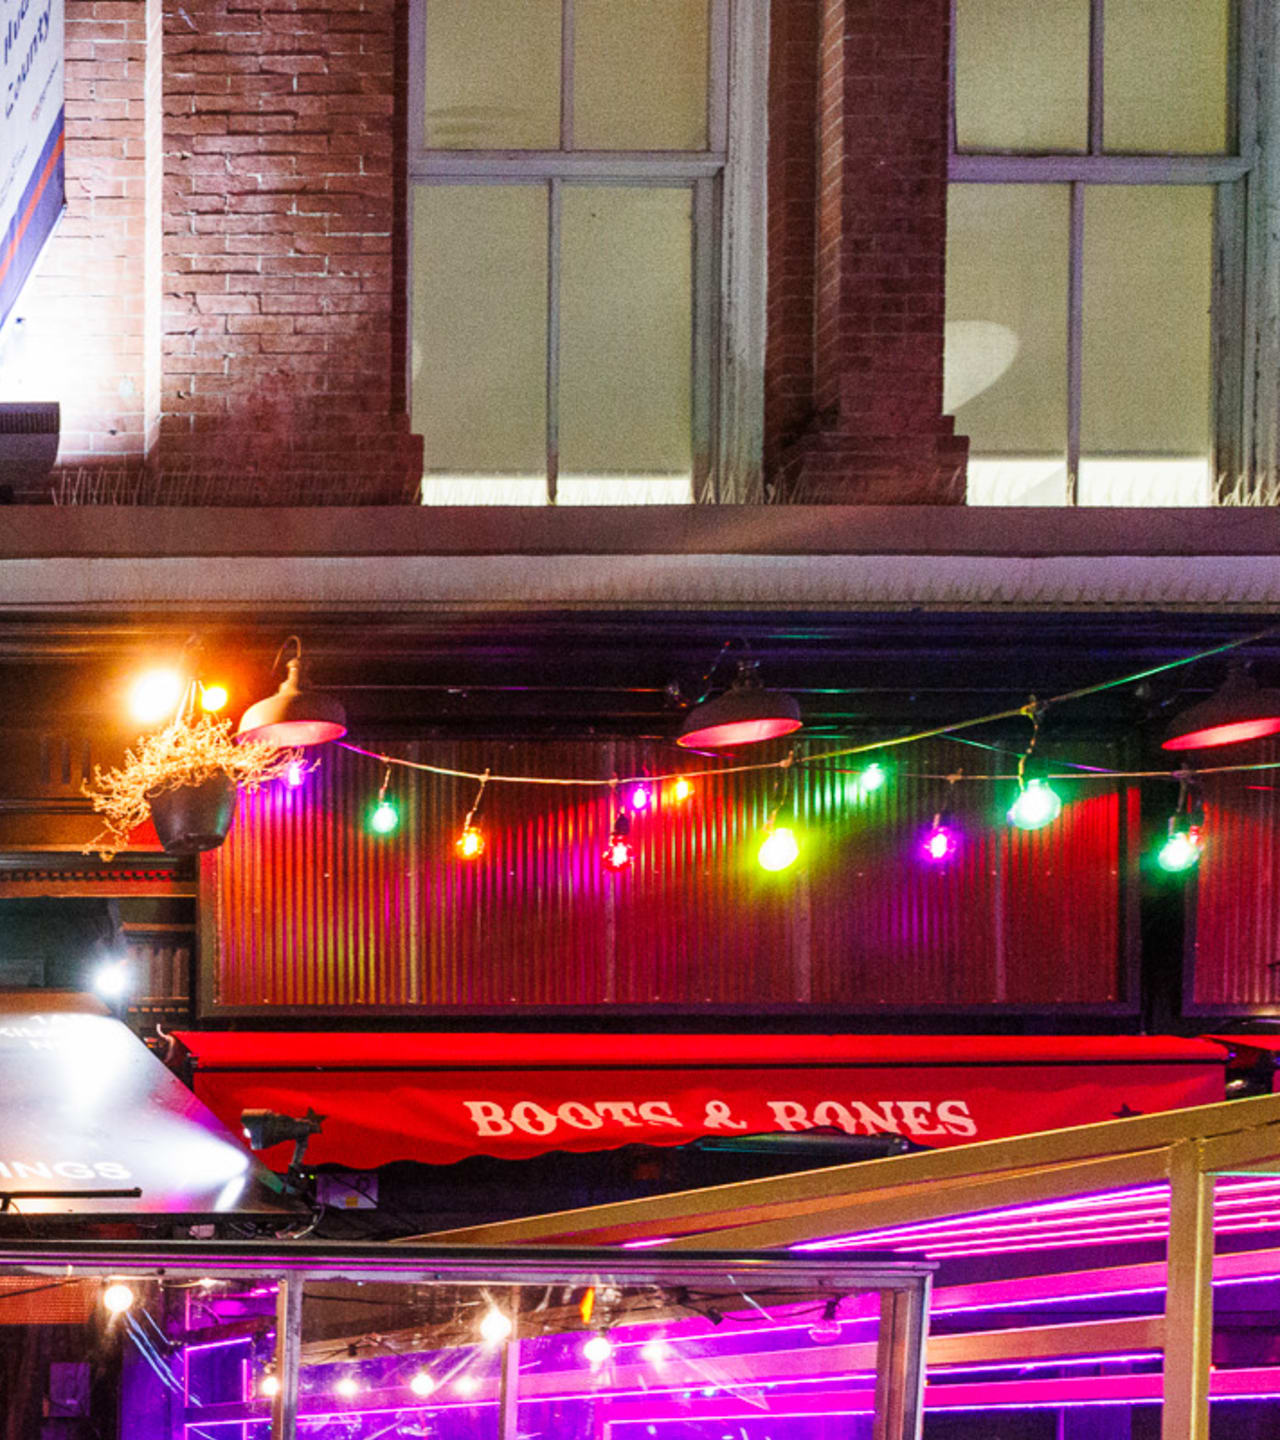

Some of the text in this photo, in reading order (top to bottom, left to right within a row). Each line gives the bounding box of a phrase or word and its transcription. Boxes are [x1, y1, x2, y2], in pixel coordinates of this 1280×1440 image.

[463, 1099, 979, 1137] BOOTS & BONES
